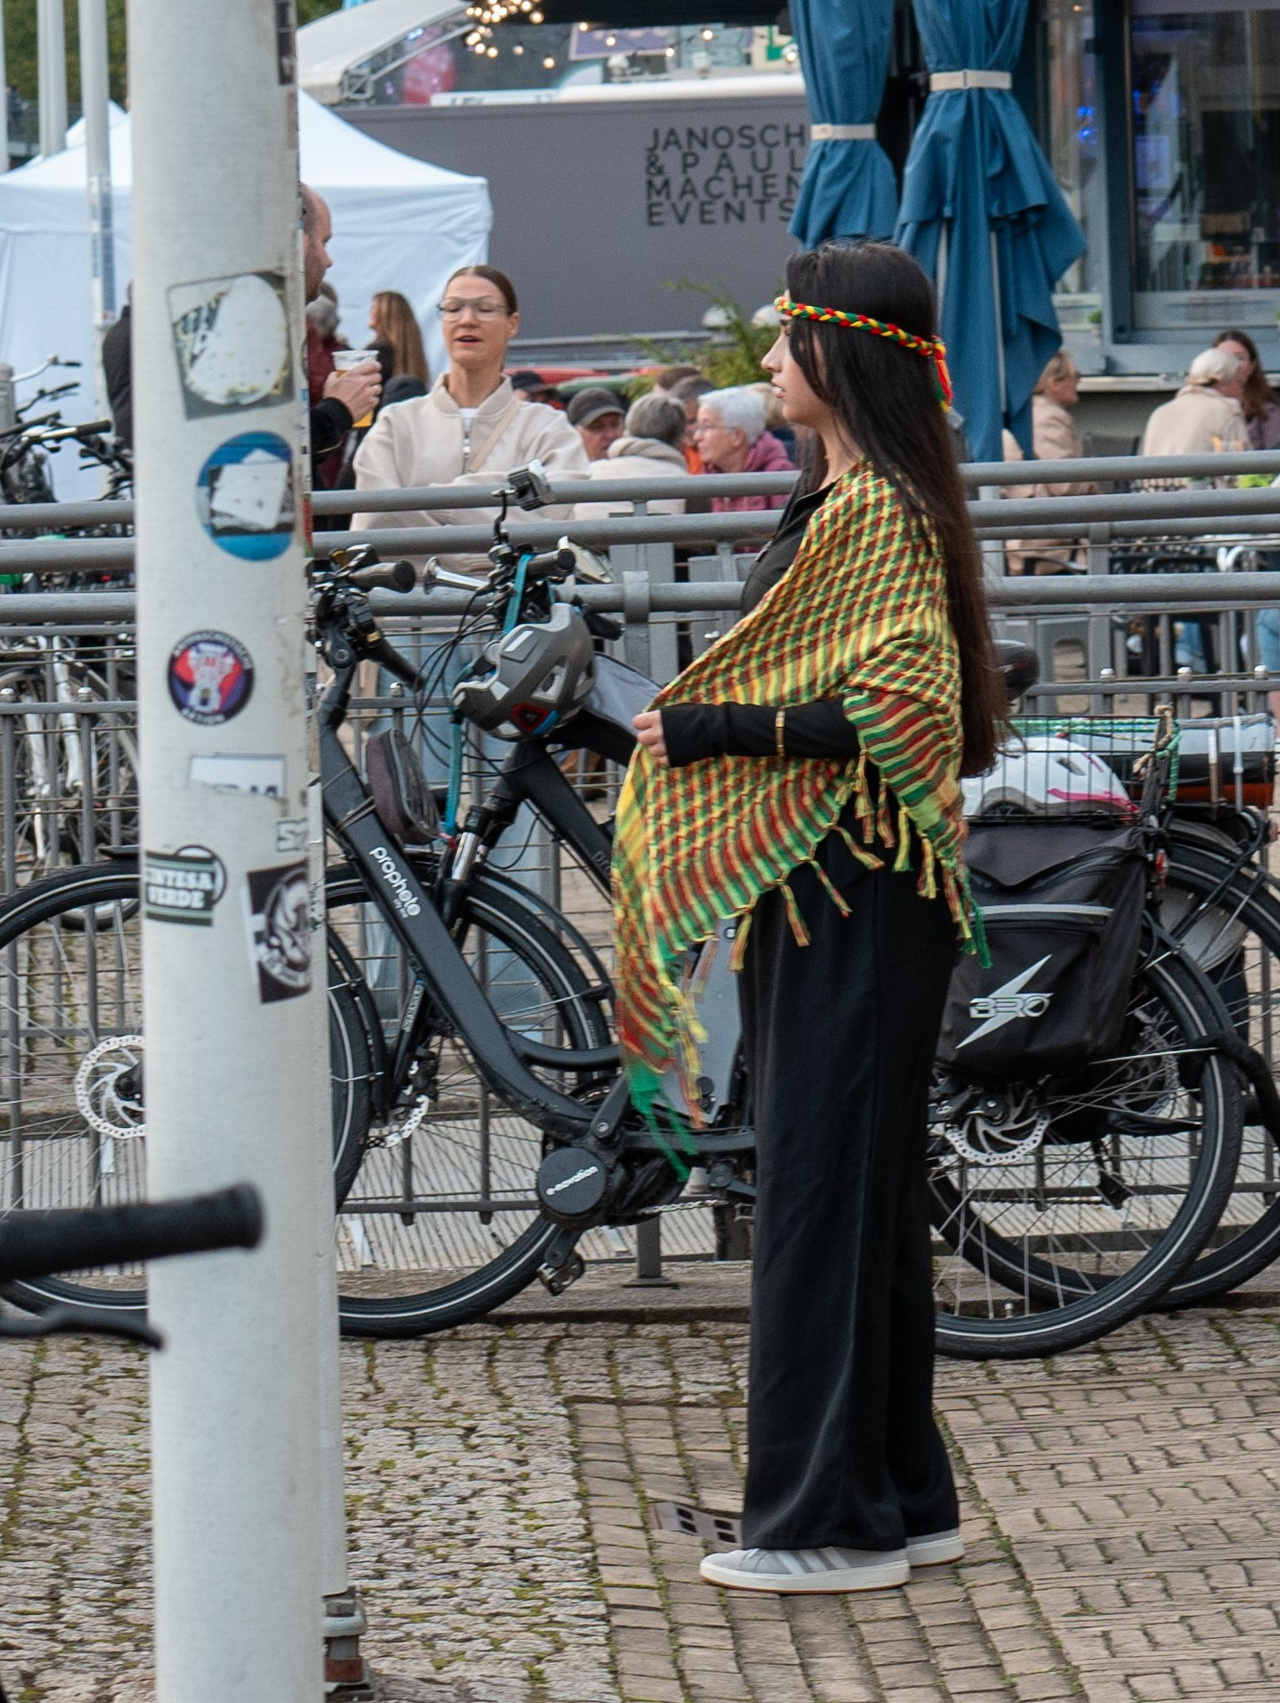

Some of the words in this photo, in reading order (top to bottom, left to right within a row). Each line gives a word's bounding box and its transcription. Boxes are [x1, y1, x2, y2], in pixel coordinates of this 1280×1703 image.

[646, 124, 805, 151] JANOSCH
[646, 152, 664, 176] &
[681, 150, 804, 174] PAUL
[646, 174, 801, 199] MACHEN
[647, 199, 794, 226] EVENTS
